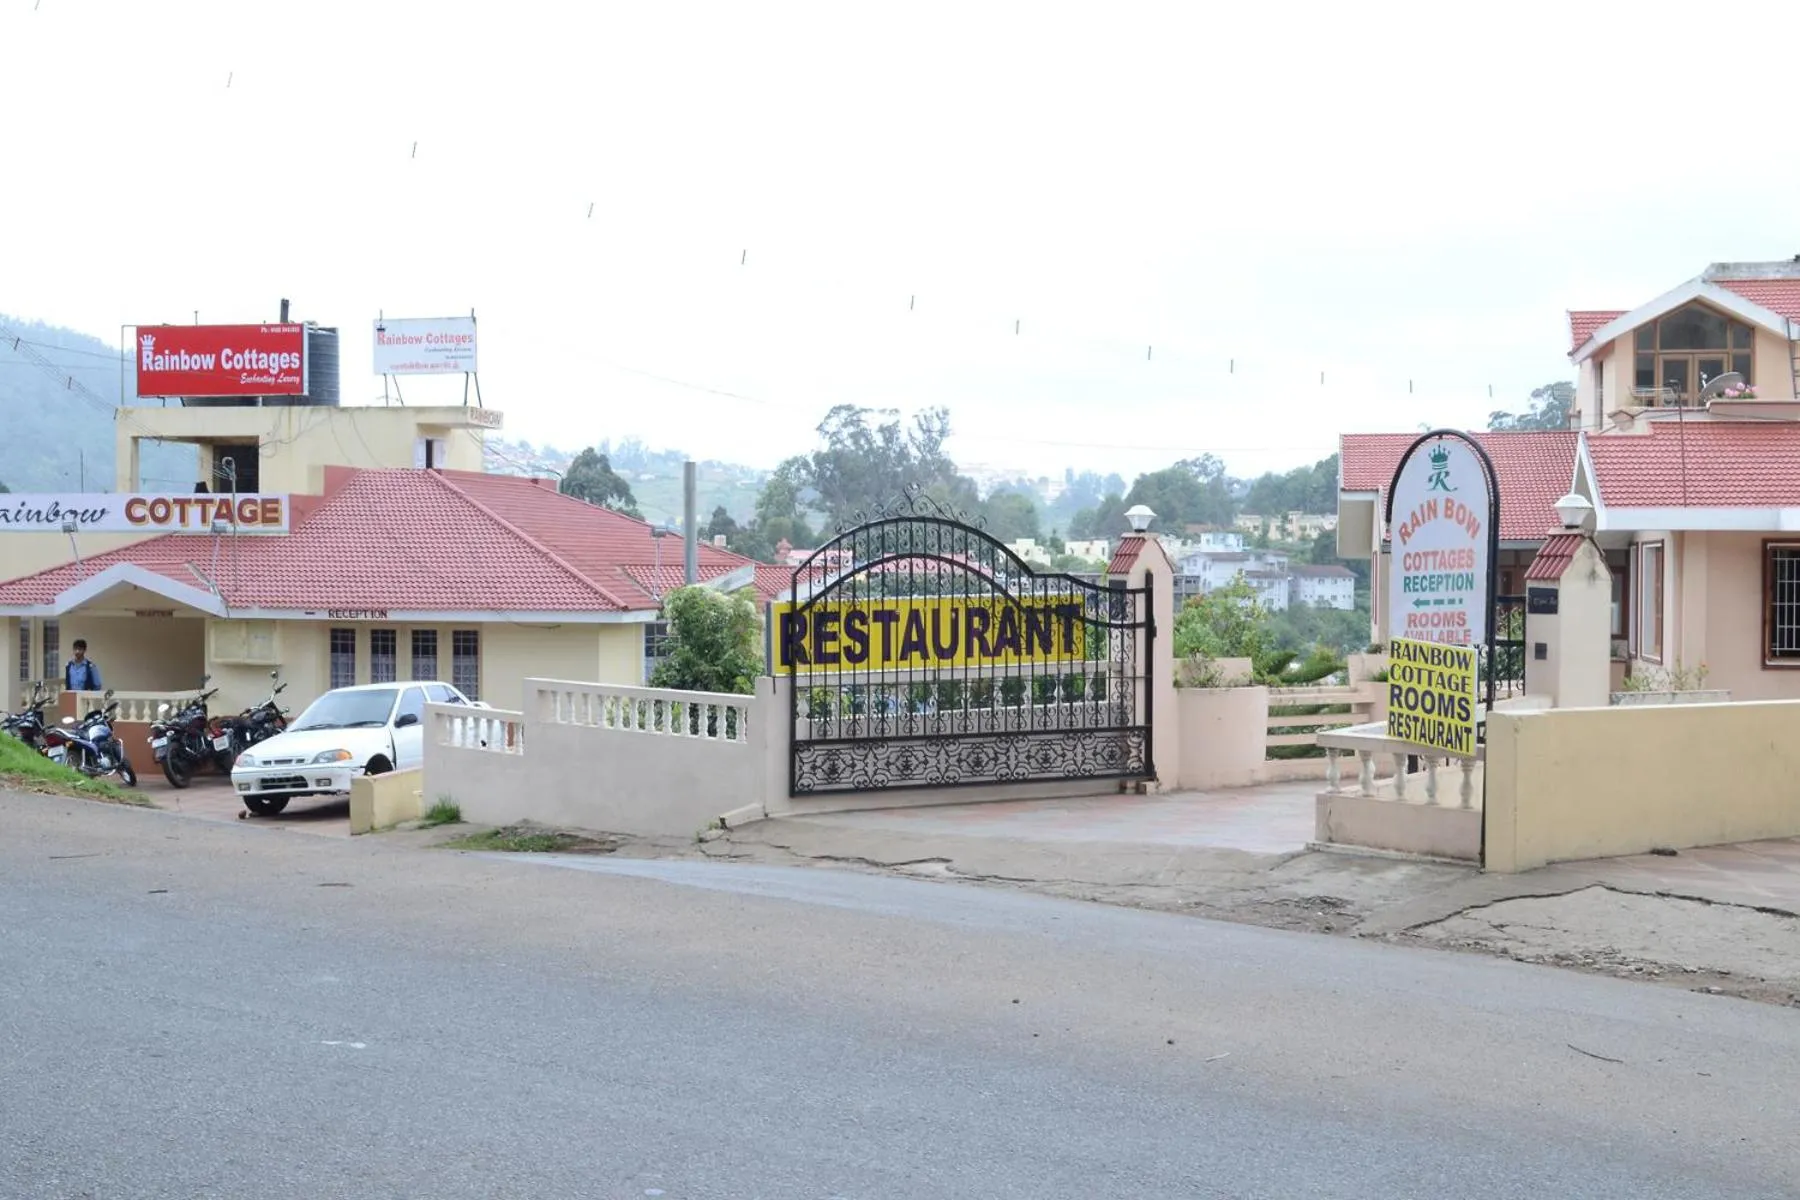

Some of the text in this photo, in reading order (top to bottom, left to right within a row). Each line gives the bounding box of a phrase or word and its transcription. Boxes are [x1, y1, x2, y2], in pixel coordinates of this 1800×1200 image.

[378, 331, 474, 346] Rainbow Cottages
[142, 348, 300, 374] Rainbow Cottages
[125, 498, 283, 527] COTTAGE
[1398, 497, 1480, 546] RAIN BOW
[1403, 548, 1475, 572] COTTAGES
[1404, 573, 1475, 593] RECEPTION
[328, 608, 388, 619] RECEPTION
[1407, 611, 1466, 628] ROOMS
[780, 603, 1080, 667] RESTAURANT
[1390, 641, 1472, 672] RAINBOW
[1390, 663, 1472, 695] COTTAGE
[1390, 684, 1471, 722] ROOMS
[1388, 711, 1472, 753] RESTAURANT
